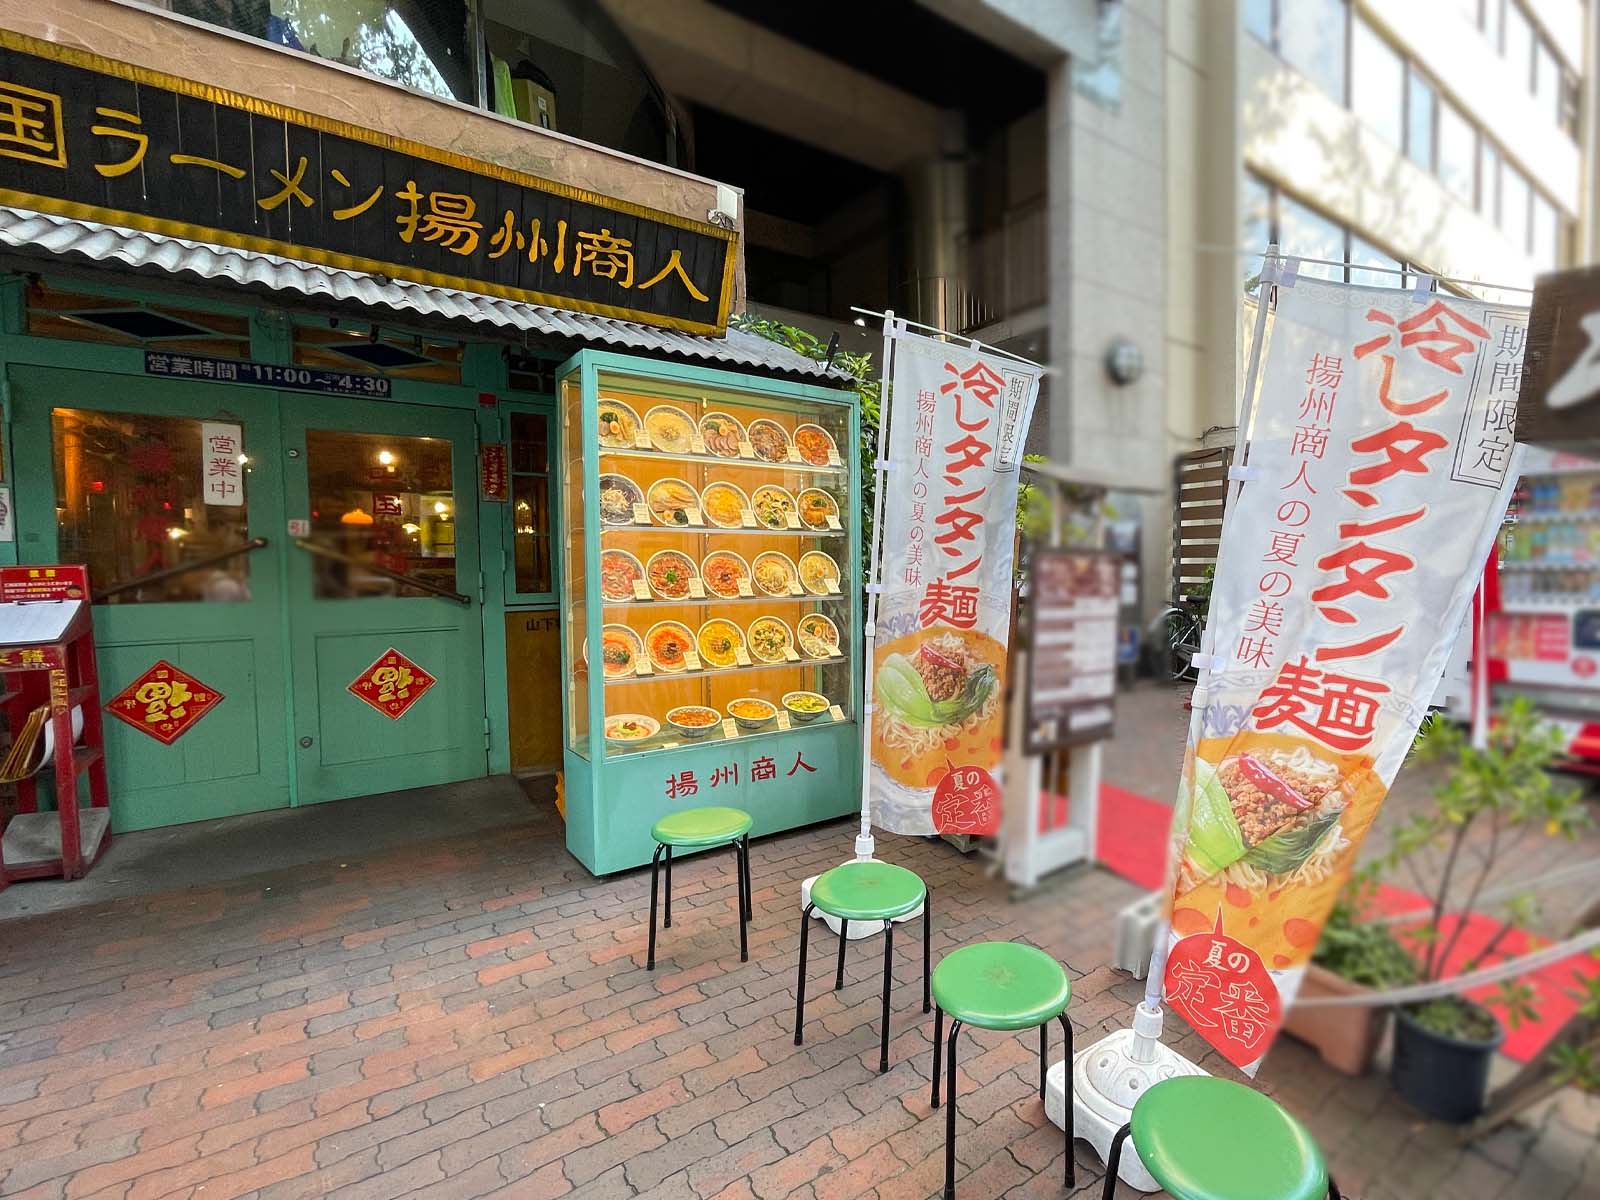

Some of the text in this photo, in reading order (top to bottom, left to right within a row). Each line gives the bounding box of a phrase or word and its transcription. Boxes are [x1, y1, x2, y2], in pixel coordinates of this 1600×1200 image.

[147, 353, 237, 380] 営業時間
[208, 434, 237, 499] 営業中
[905, 389, 937, 588] 揚州商人の夏の美味
[919, 361, 1006, 629] 冷しタンタン麺
[1236, 352, 1346, 669] 揚州商人の夏の美味
[1251, 300, 1492, 751] 冷しタンタン麺
[665, 751, 818, 799] 揚州商人
[1202, 939, 1251, 974] 夏の
[1166, 959, 1274, 1049] 定番
